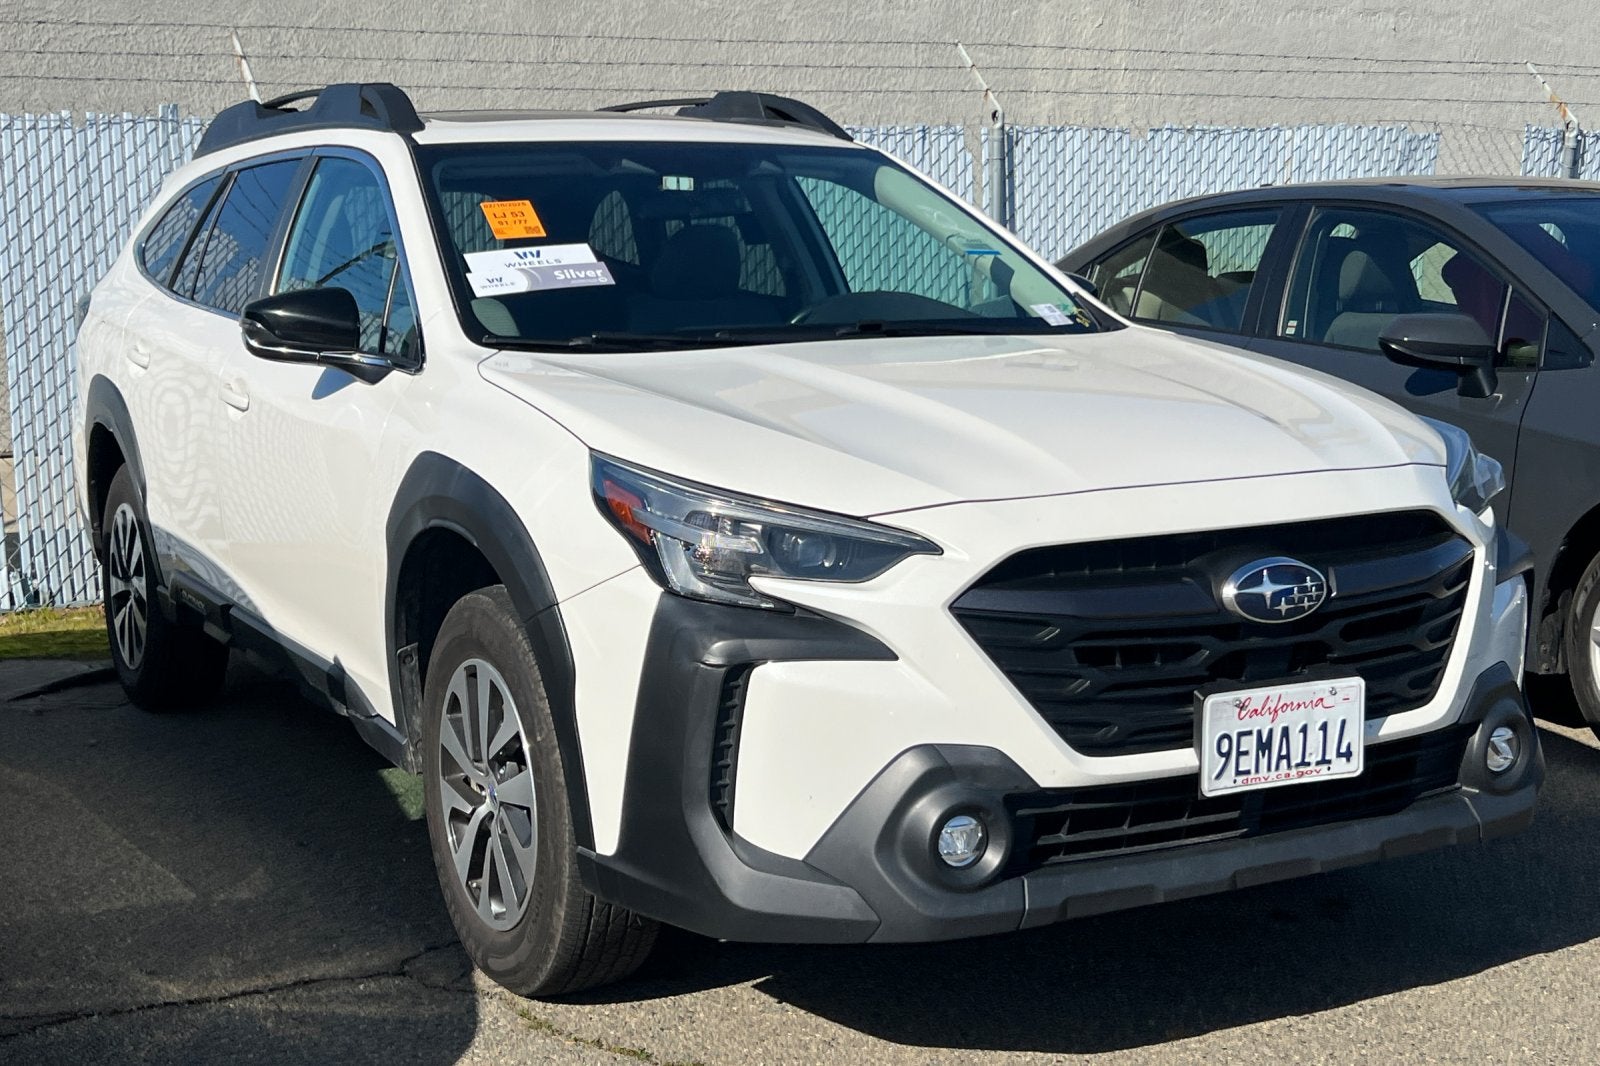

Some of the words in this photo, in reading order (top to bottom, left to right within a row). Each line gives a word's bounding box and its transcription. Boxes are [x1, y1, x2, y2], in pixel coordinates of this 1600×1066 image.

[504, 258, 562, 268] WHEELS
[553, 268, 603, 280] Silver
[1237, 694, 1335, 723] California
[1213, 718, 1353, 781] 9EMA114
[1241, 767, 1322, 785] dmv.ca.gov
